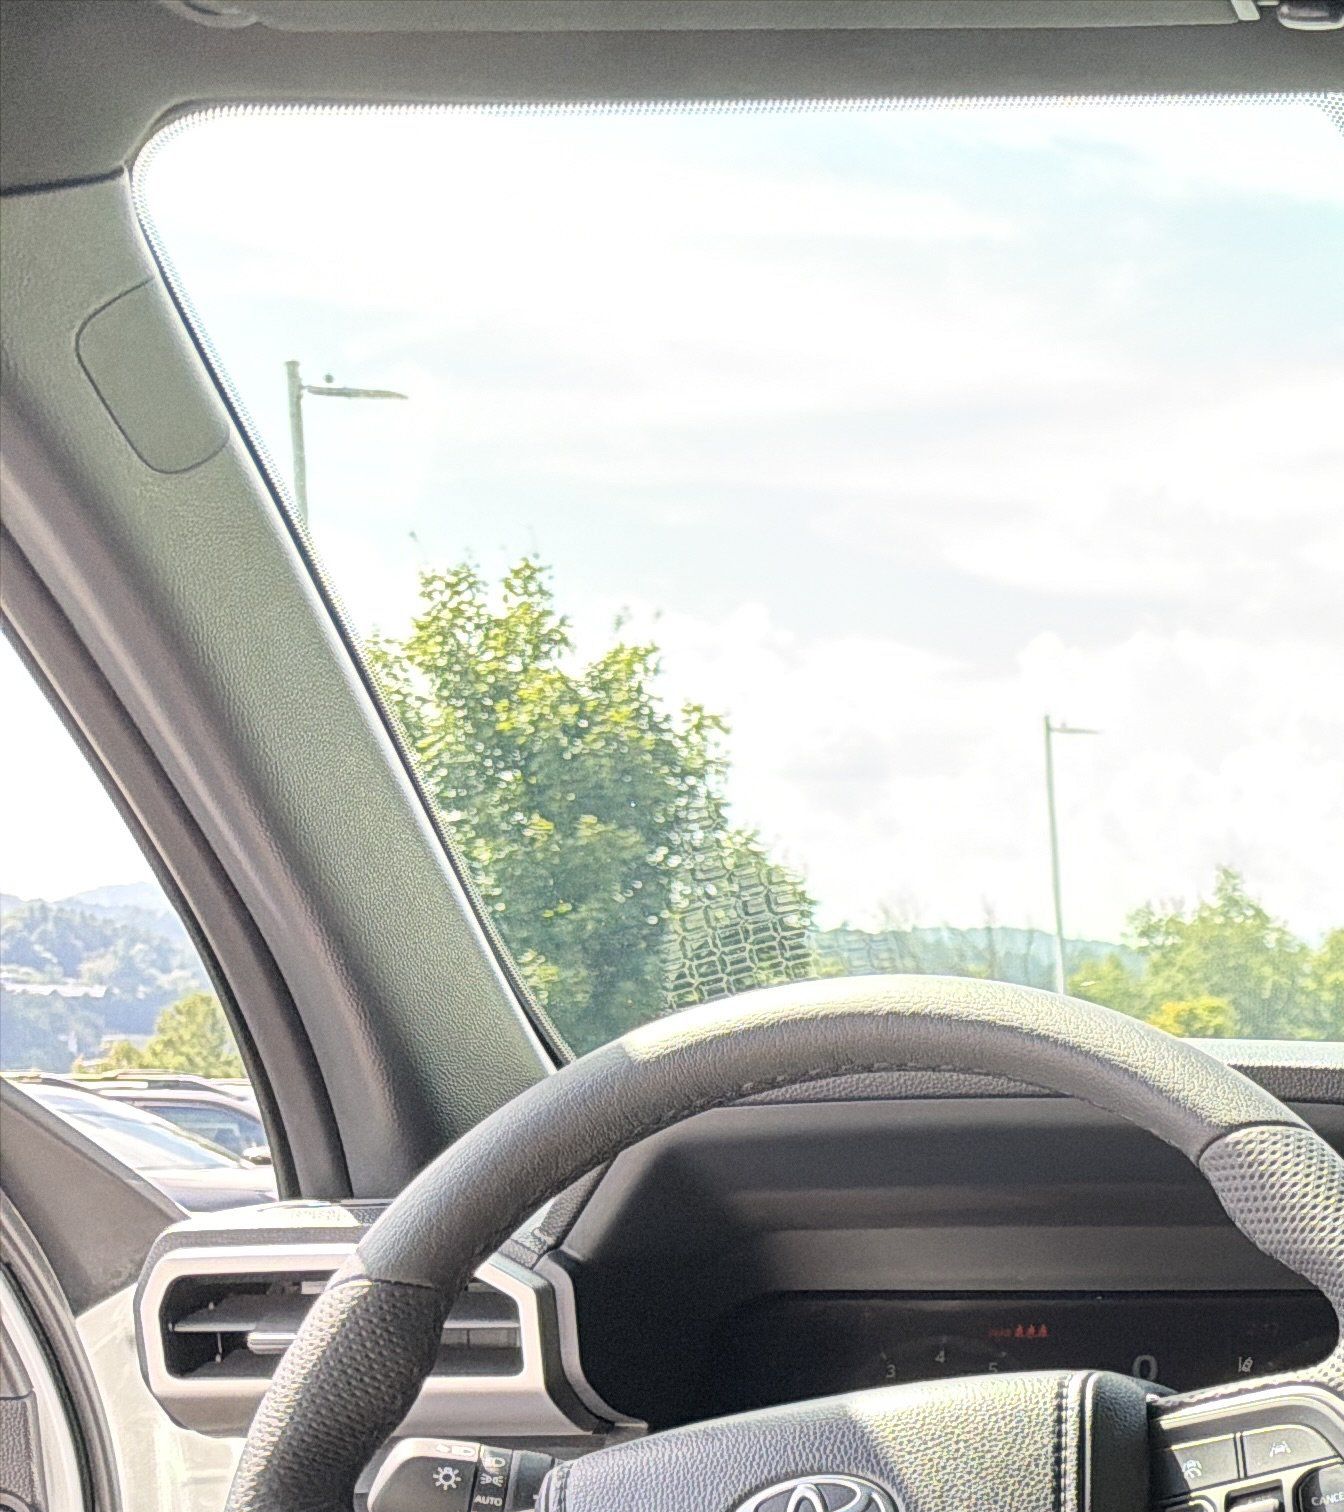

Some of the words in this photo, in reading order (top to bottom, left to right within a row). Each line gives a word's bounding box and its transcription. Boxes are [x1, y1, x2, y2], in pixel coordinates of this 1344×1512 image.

[935, 1350, 946, 1364] 4
[886, 1364, 896, 1378] 3
[473, 1495, 503, 1507] AUTO
